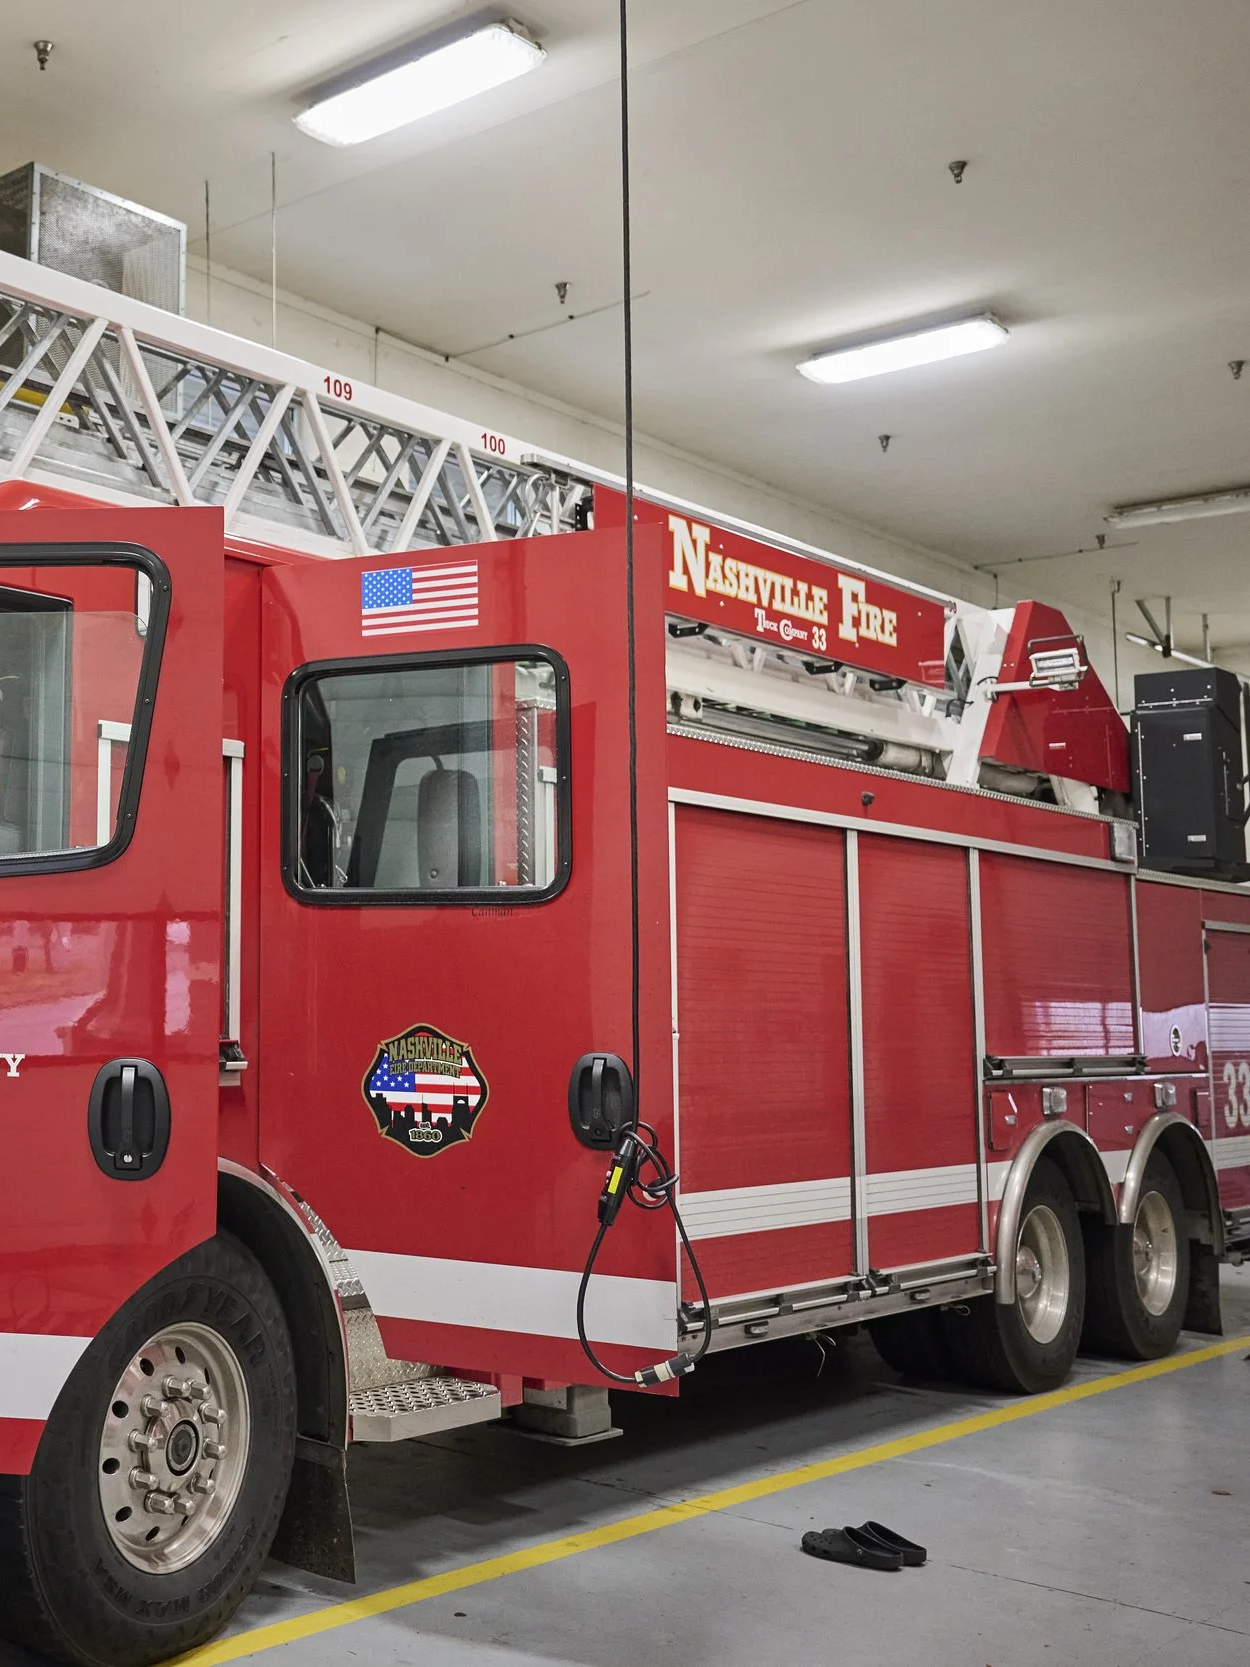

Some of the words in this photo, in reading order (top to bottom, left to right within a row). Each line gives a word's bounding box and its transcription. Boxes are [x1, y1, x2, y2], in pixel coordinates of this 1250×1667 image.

[323, 376, 353, 401] 109
[481, 432, 506, 455] 100
[668, 514, 829, 626] NASHVILLE
[837, 572, 898, 648] FIRE
[754, 607, 779, 633] TRUCK
[779, 618, 808, 641] COMPANY
[811, 625, 827, 651] 33
[389, 1035, 463, 1066] NASHVILLE
[390, 1062, 409, 1075] FIRE
[408, 1060, 462, 1079] DEPARTMENT
[1223, 1061, 1250, 1128] 33
[409, 1129, 442, 1142] 1860
